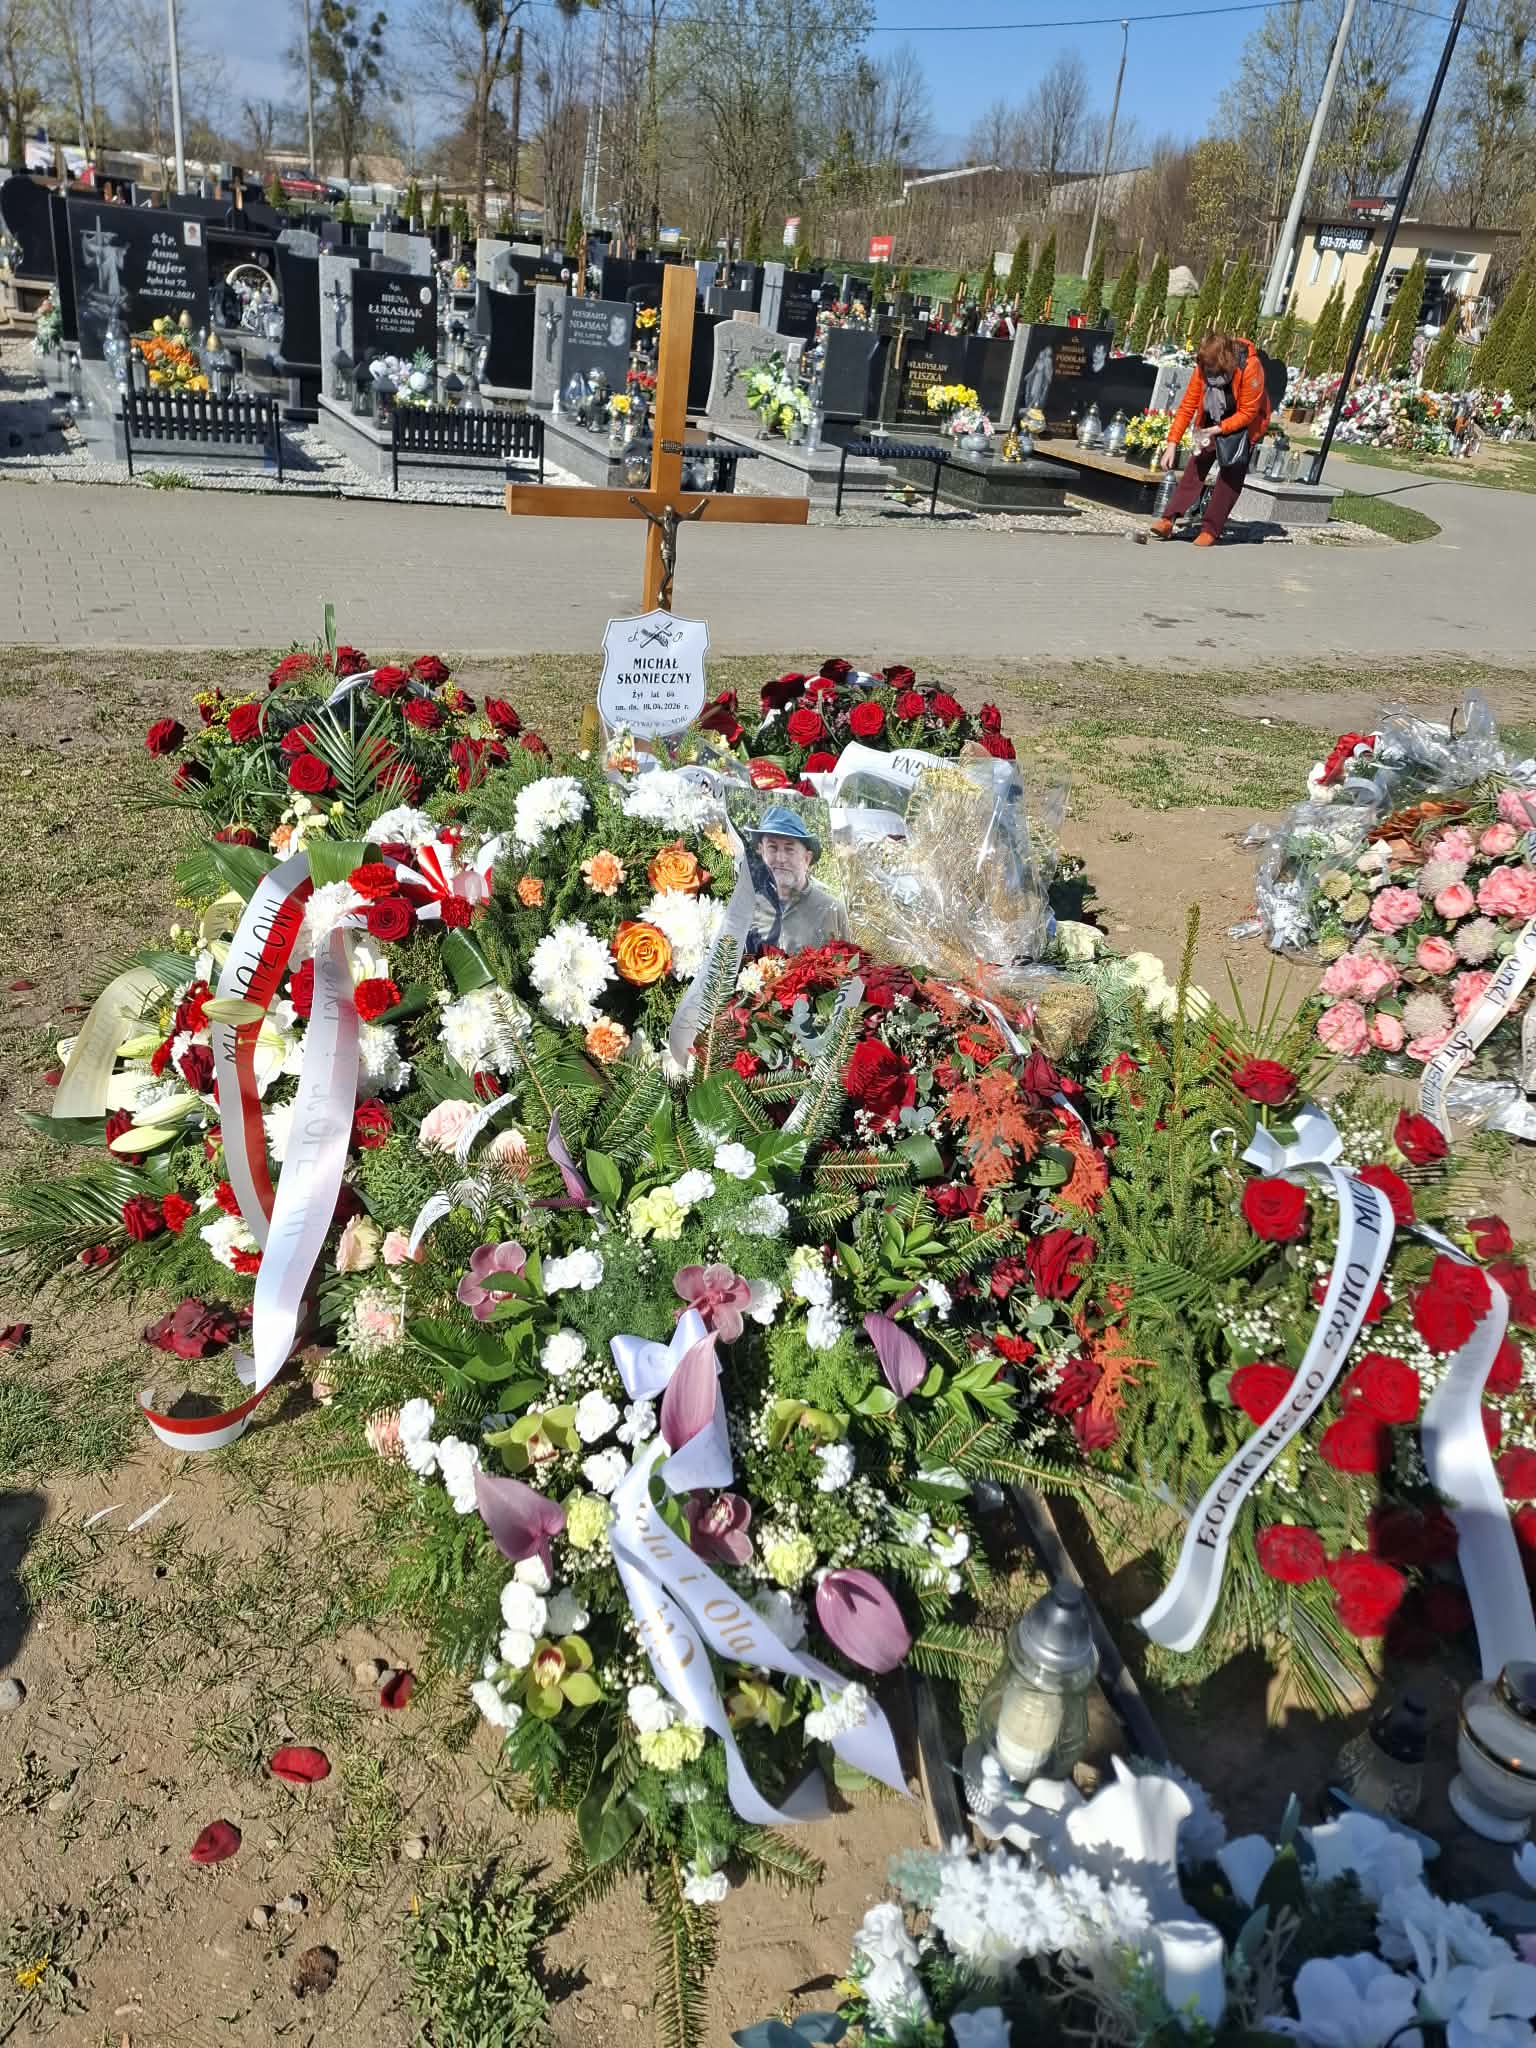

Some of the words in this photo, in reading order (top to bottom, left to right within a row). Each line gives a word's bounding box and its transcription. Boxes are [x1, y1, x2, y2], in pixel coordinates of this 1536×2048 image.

[368, 303, 423, 318] ŁUKASIAK
[633, 658, 678, 669] MICHAŁ
[616, 673, 692, 685] SKONIECZNY
[703, 1598, 757, 1655] Ola
